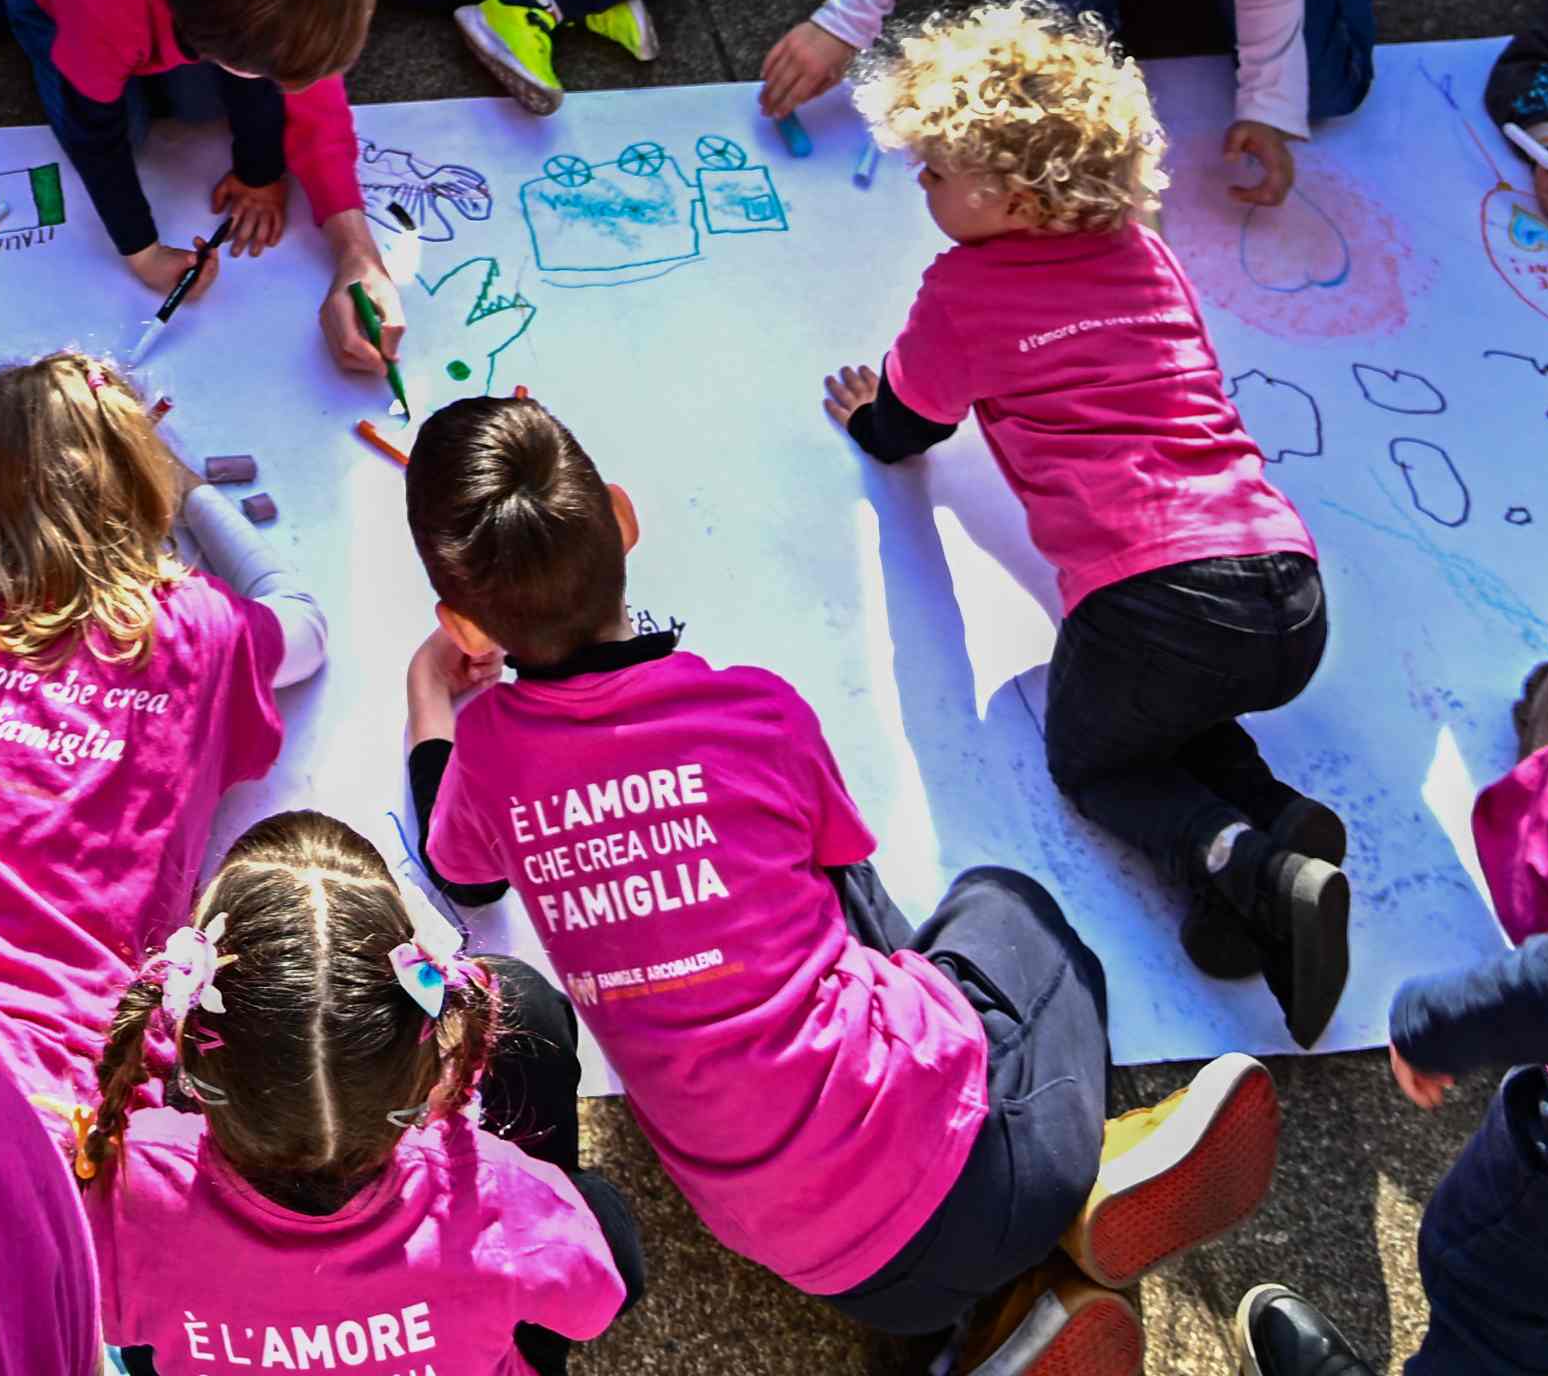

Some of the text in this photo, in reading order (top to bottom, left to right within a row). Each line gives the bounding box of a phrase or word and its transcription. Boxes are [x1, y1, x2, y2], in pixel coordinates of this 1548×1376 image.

[103, 686, 170, 715] crea
[510, 763, 708, 844] È L'AMORE
[523, 814, 718, 885] CHE CREA UNA
[537, 857, 731, 934] FAMIGLIA
[647, 947, 725, 983] ARCOBALENO
[183, 1301, 437, 1371] È L'AMORE
